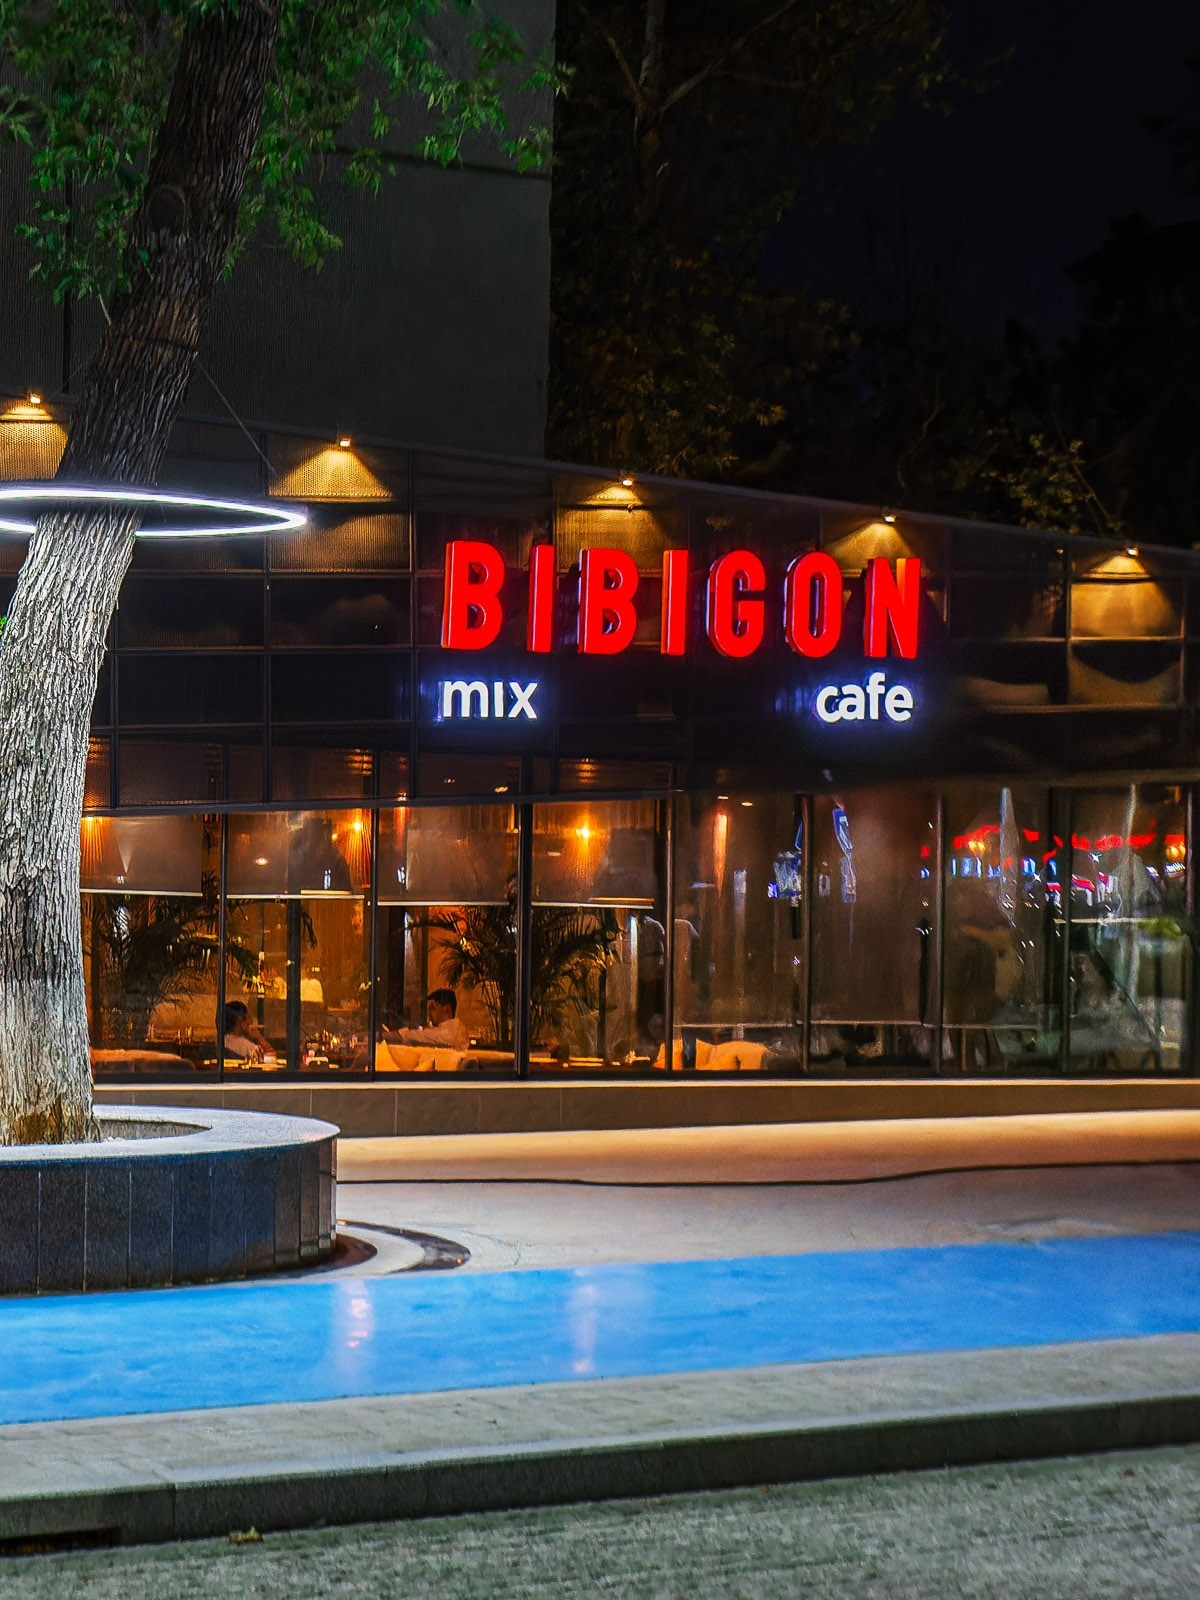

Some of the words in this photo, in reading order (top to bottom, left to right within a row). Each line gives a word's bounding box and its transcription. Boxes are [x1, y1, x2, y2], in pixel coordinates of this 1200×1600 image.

[441, 540, 921, 659] BIBIGON
[441, 680, 538, 720] mix
[816, 672, 914, 723] cafe
